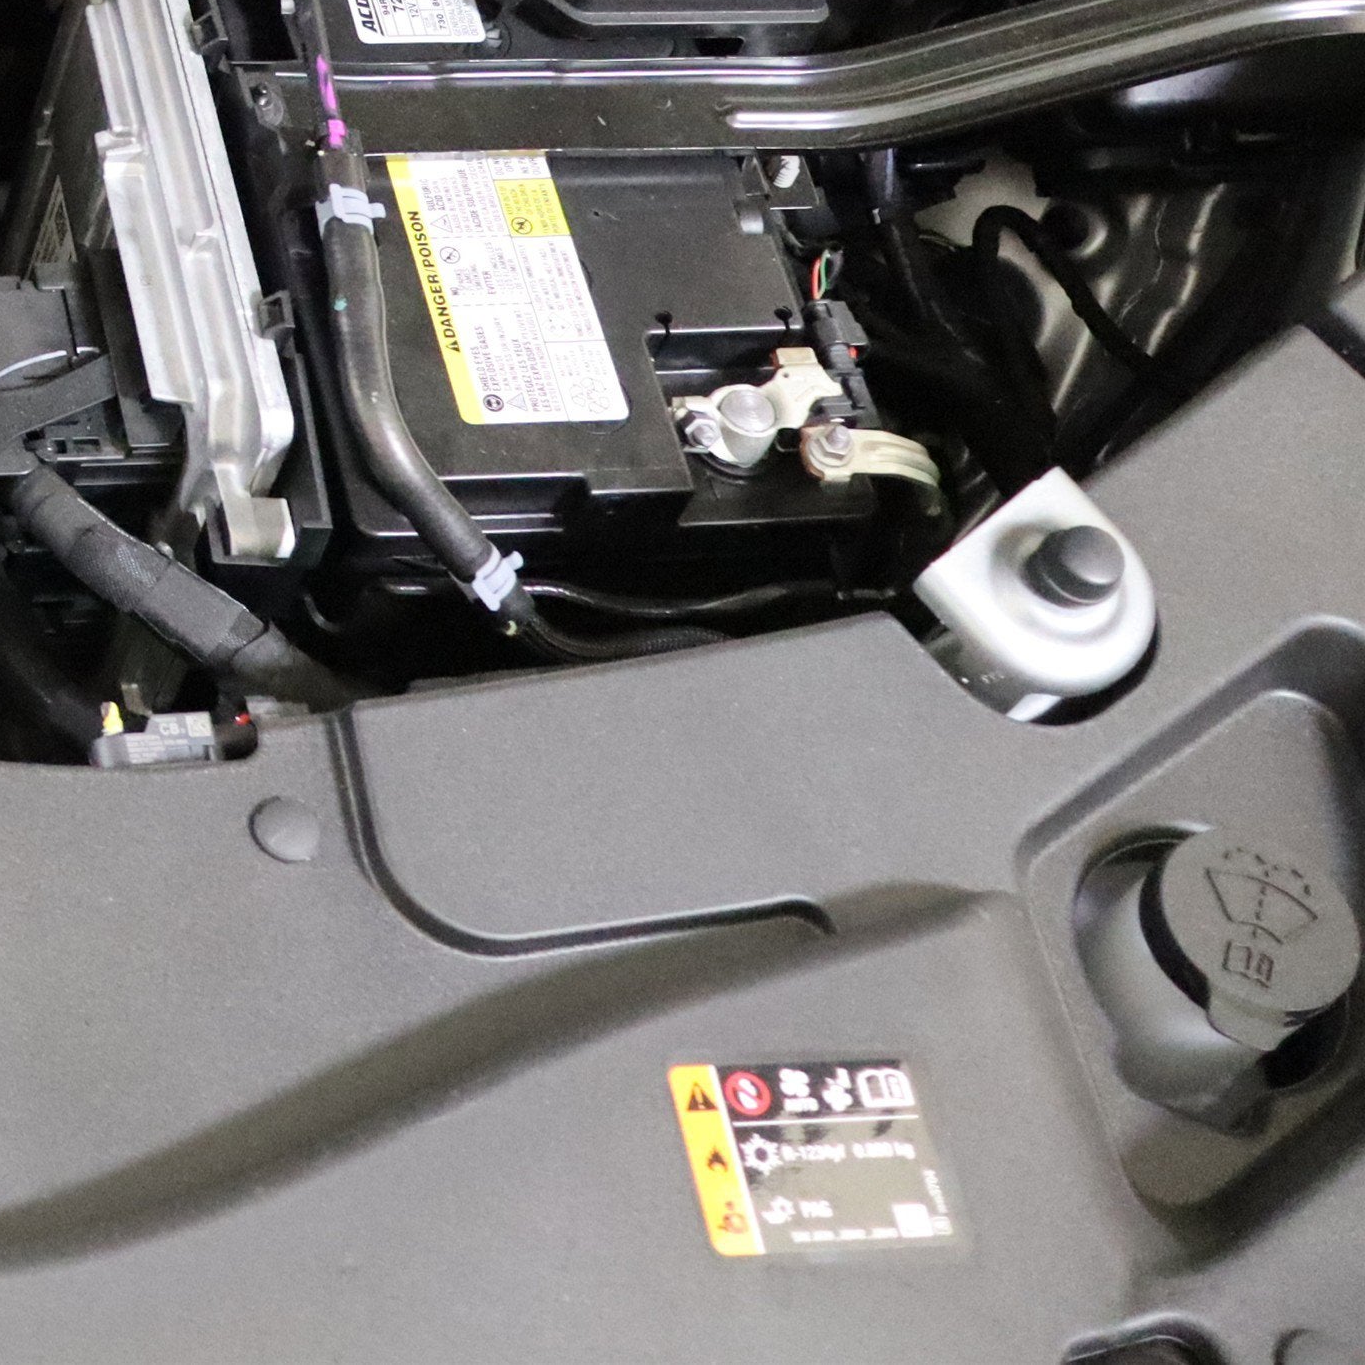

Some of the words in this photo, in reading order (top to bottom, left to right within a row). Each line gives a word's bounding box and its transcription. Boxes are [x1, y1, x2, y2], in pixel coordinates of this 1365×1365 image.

[407, 2, 419, 17] 12V
[407, 210, 456, 338] DANGER/POISON
[472, 325, 489, 349] GASES
[480, 351, 502, 391] EXPLOSIVE
